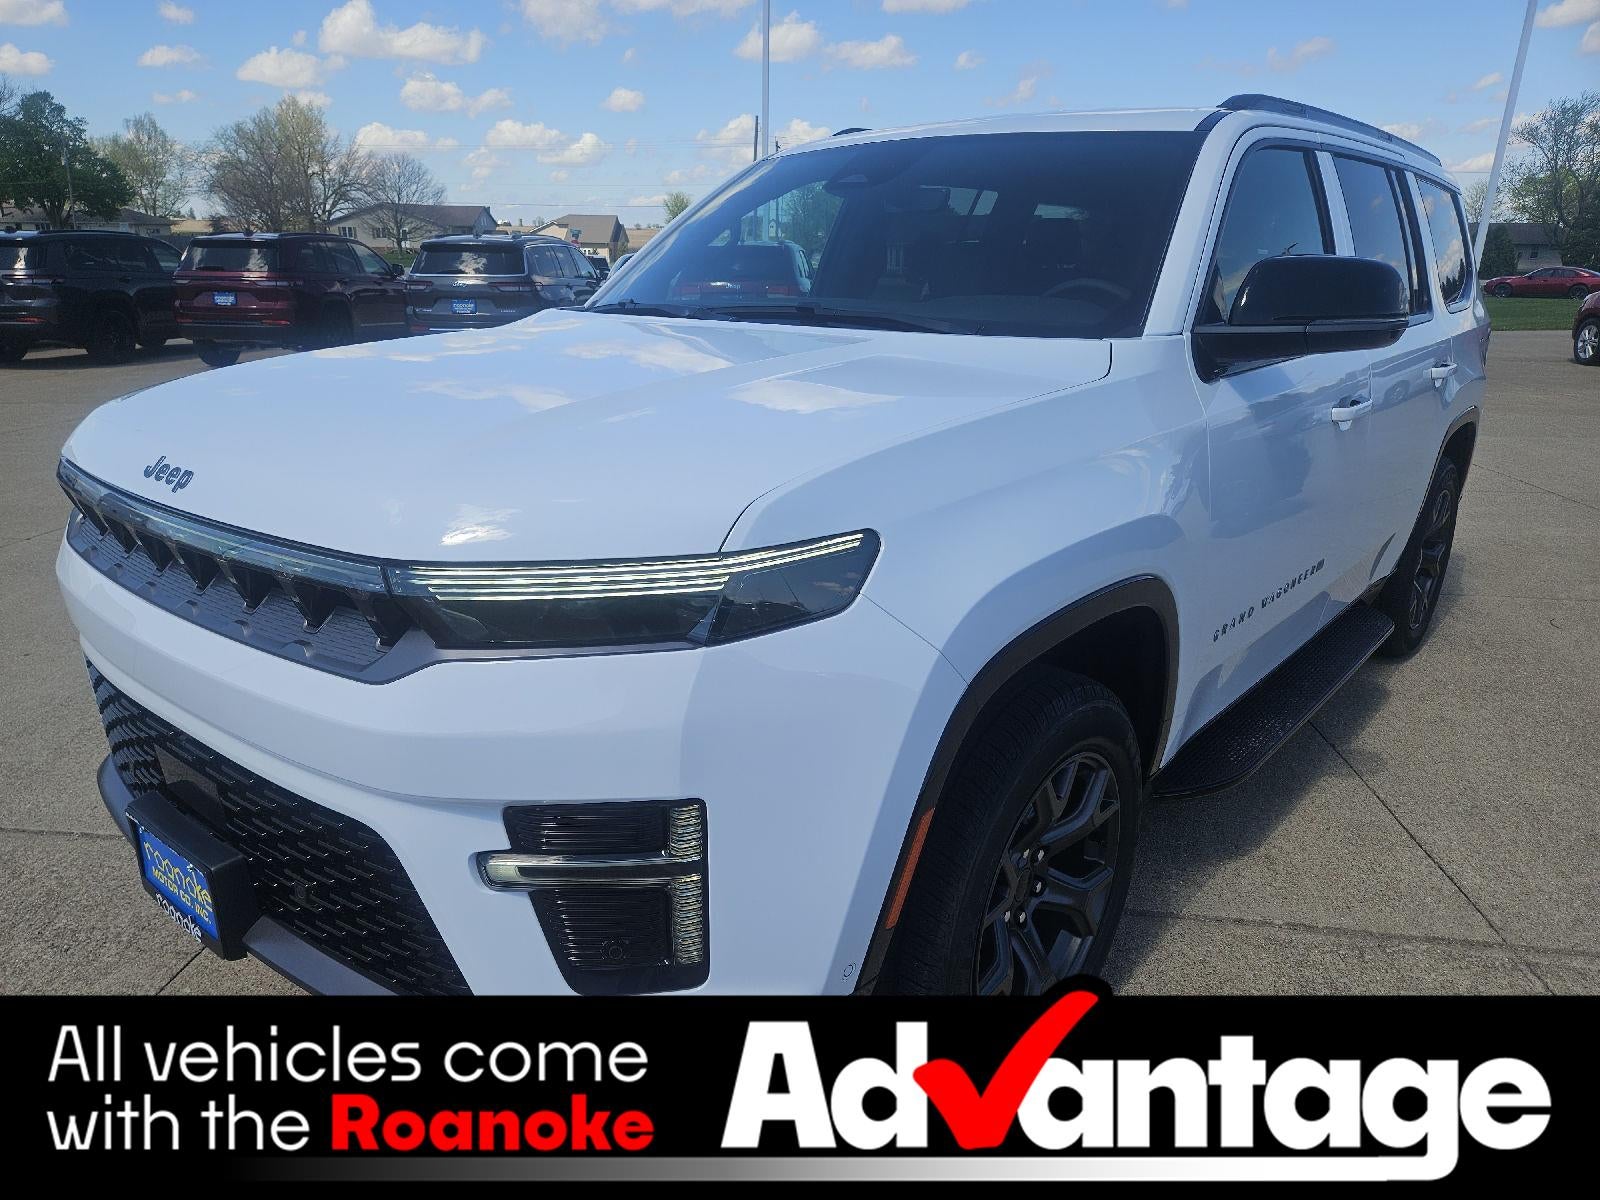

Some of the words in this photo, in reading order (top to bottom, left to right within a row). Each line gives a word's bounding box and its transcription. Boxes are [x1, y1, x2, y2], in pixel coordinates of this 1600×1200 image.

[144, 456, 194, 493] Jeep
[1213, 606, 1254, 642] GRAND
[152, 865, 179, 895] MOTOR
